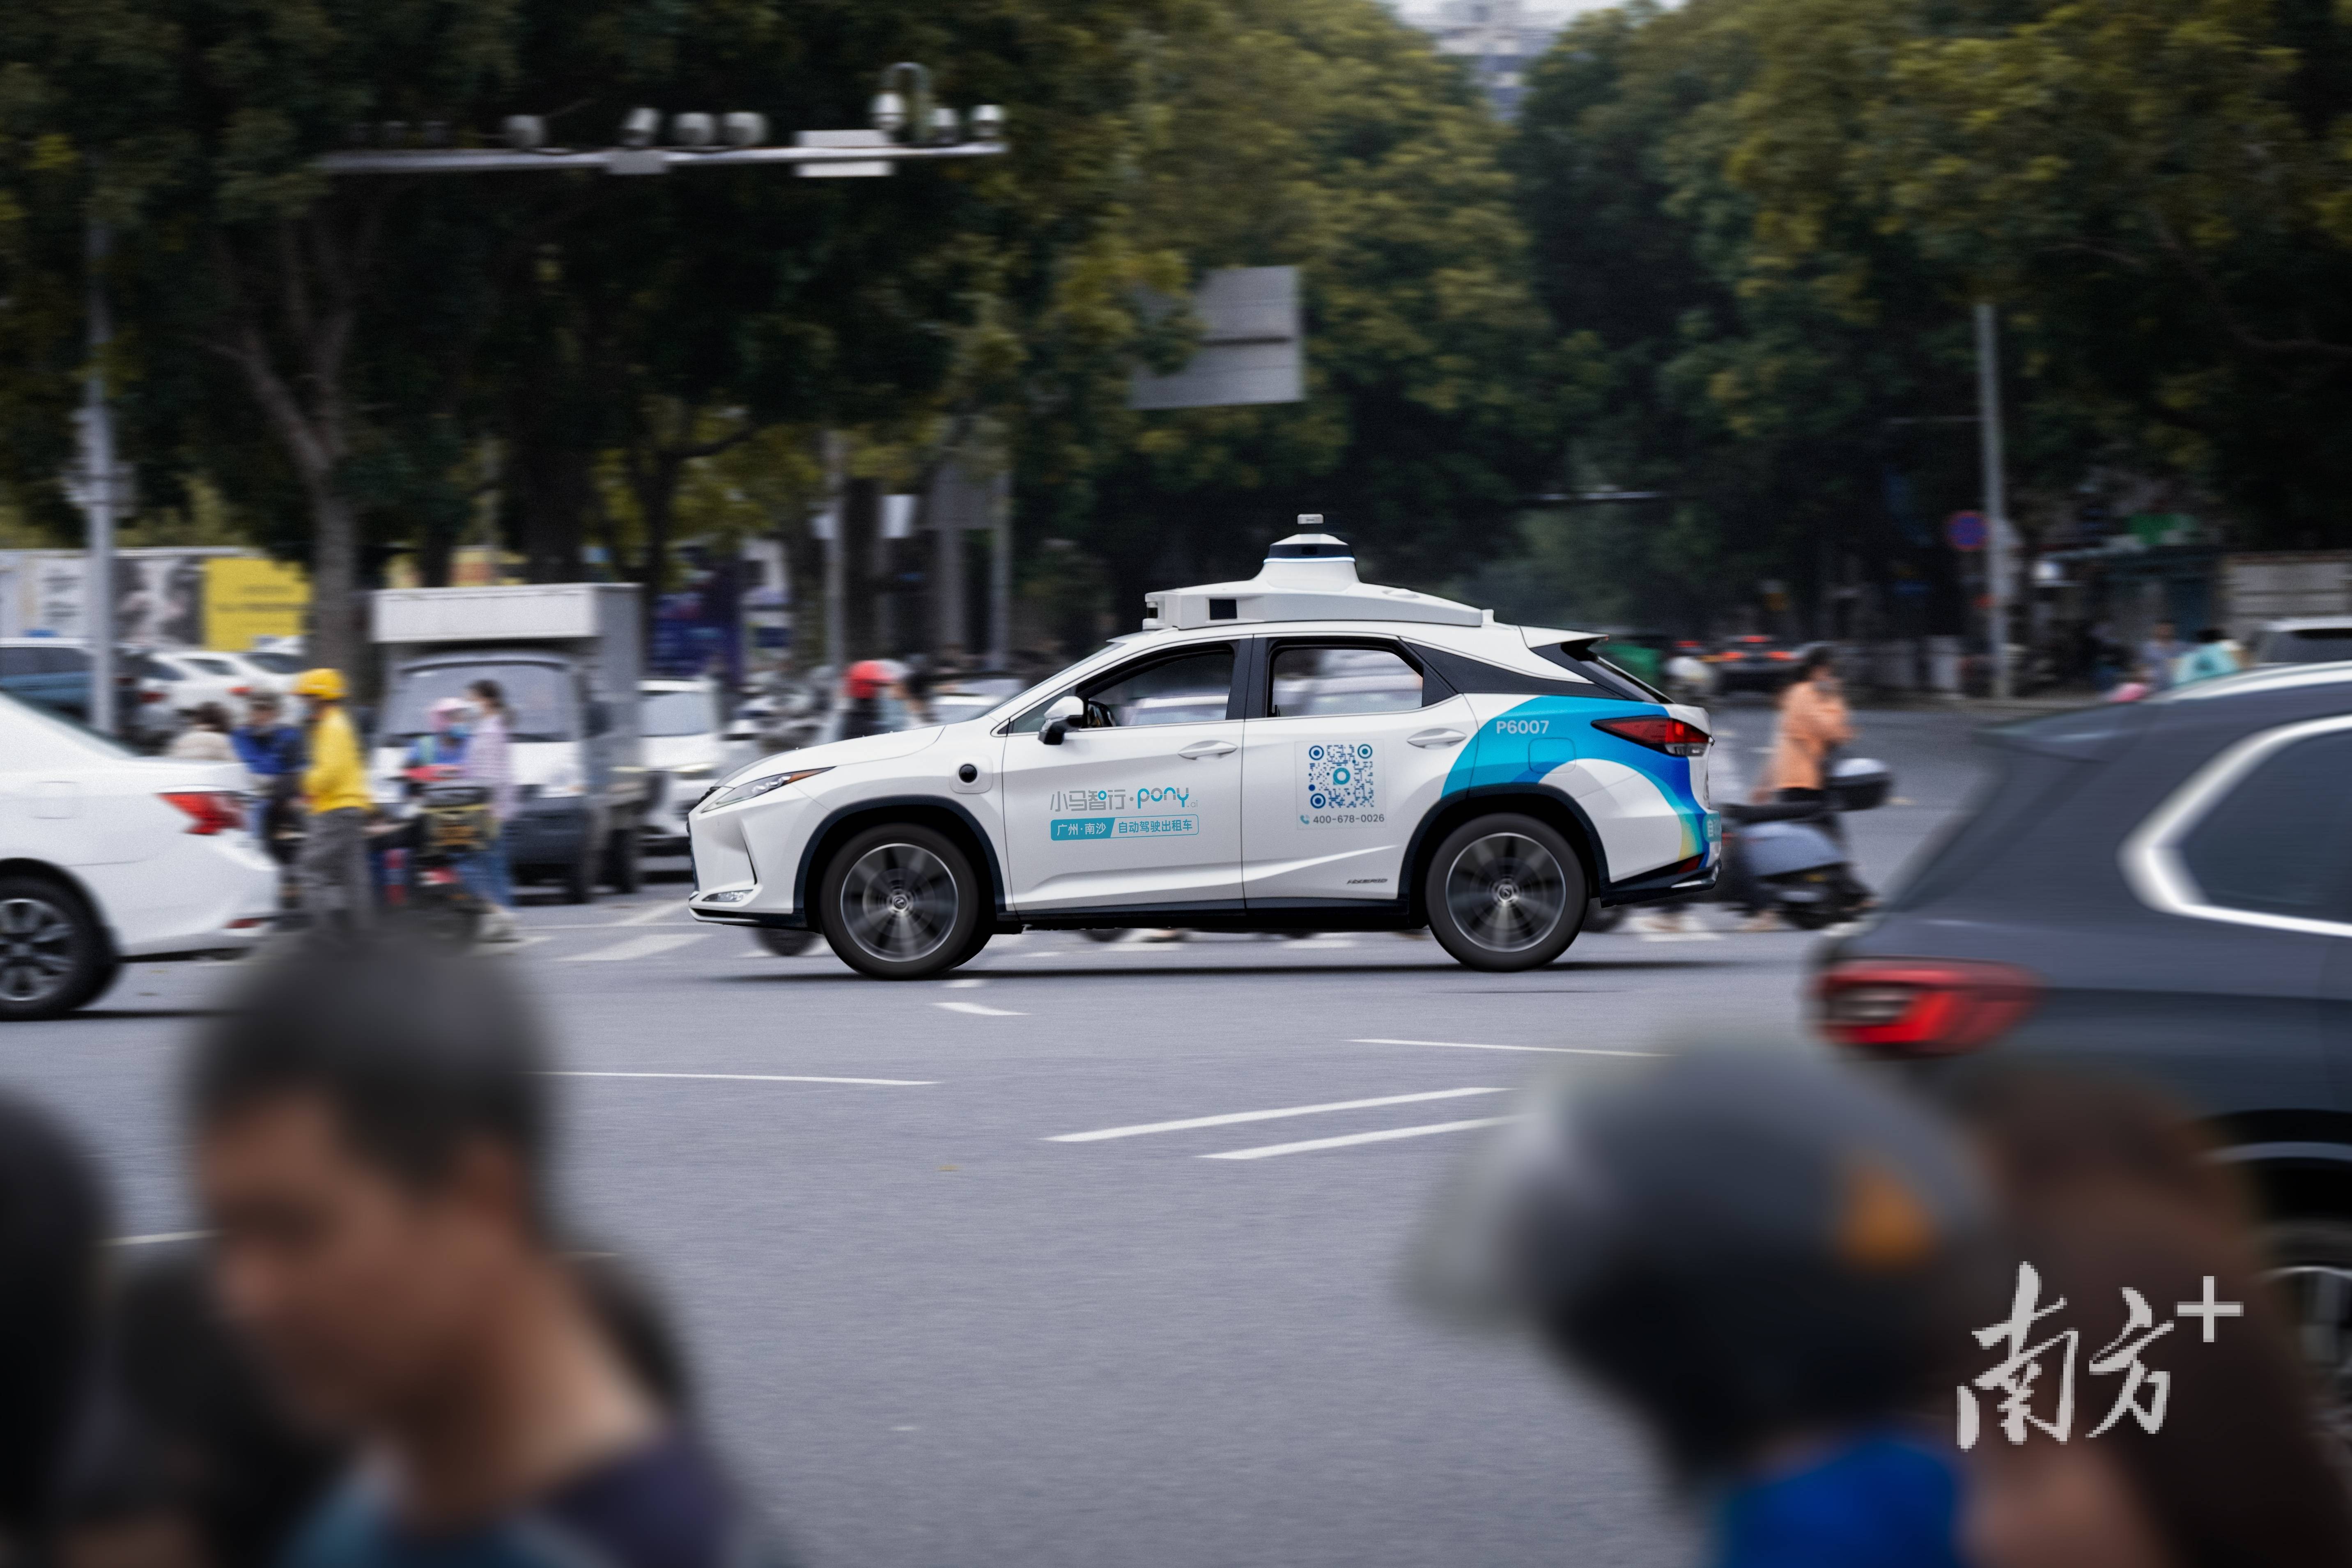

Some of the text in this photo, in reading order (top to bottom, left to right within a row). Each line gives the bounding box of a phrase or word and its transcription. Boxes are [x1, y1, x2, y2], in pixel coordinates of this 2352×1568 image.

[1496, 720, 1549, 734] P6007
[1313, 814, 1385, 824] 400-678-0026
[1118, 819, 1193, 834] 自动驾驶出租车
